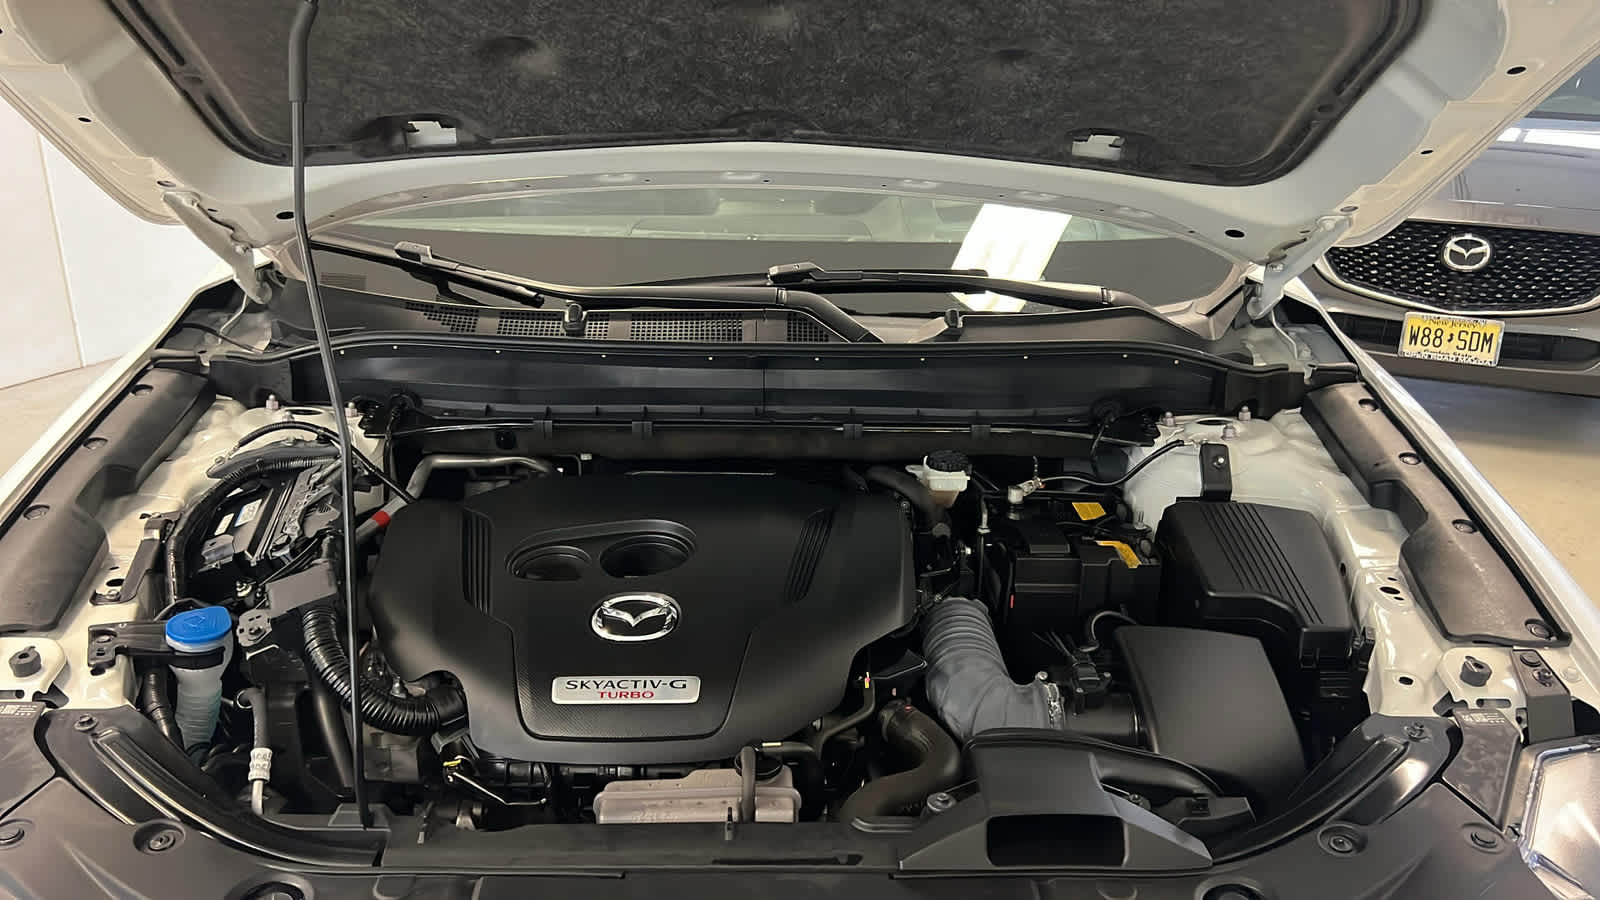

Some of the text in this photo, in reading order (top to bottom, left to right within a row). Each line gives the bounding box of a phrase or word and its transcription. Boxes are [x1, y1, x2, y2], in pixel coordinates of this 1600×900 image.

[1429, 318, 1448, 326] New
[1449, 320, 1478, 329] Jersey
[1408, 325, 1494, 353] W88 SDM
[565, 679, 688, 690] SKYACTIV-G
[597, 691, 654, 699] TURBO
